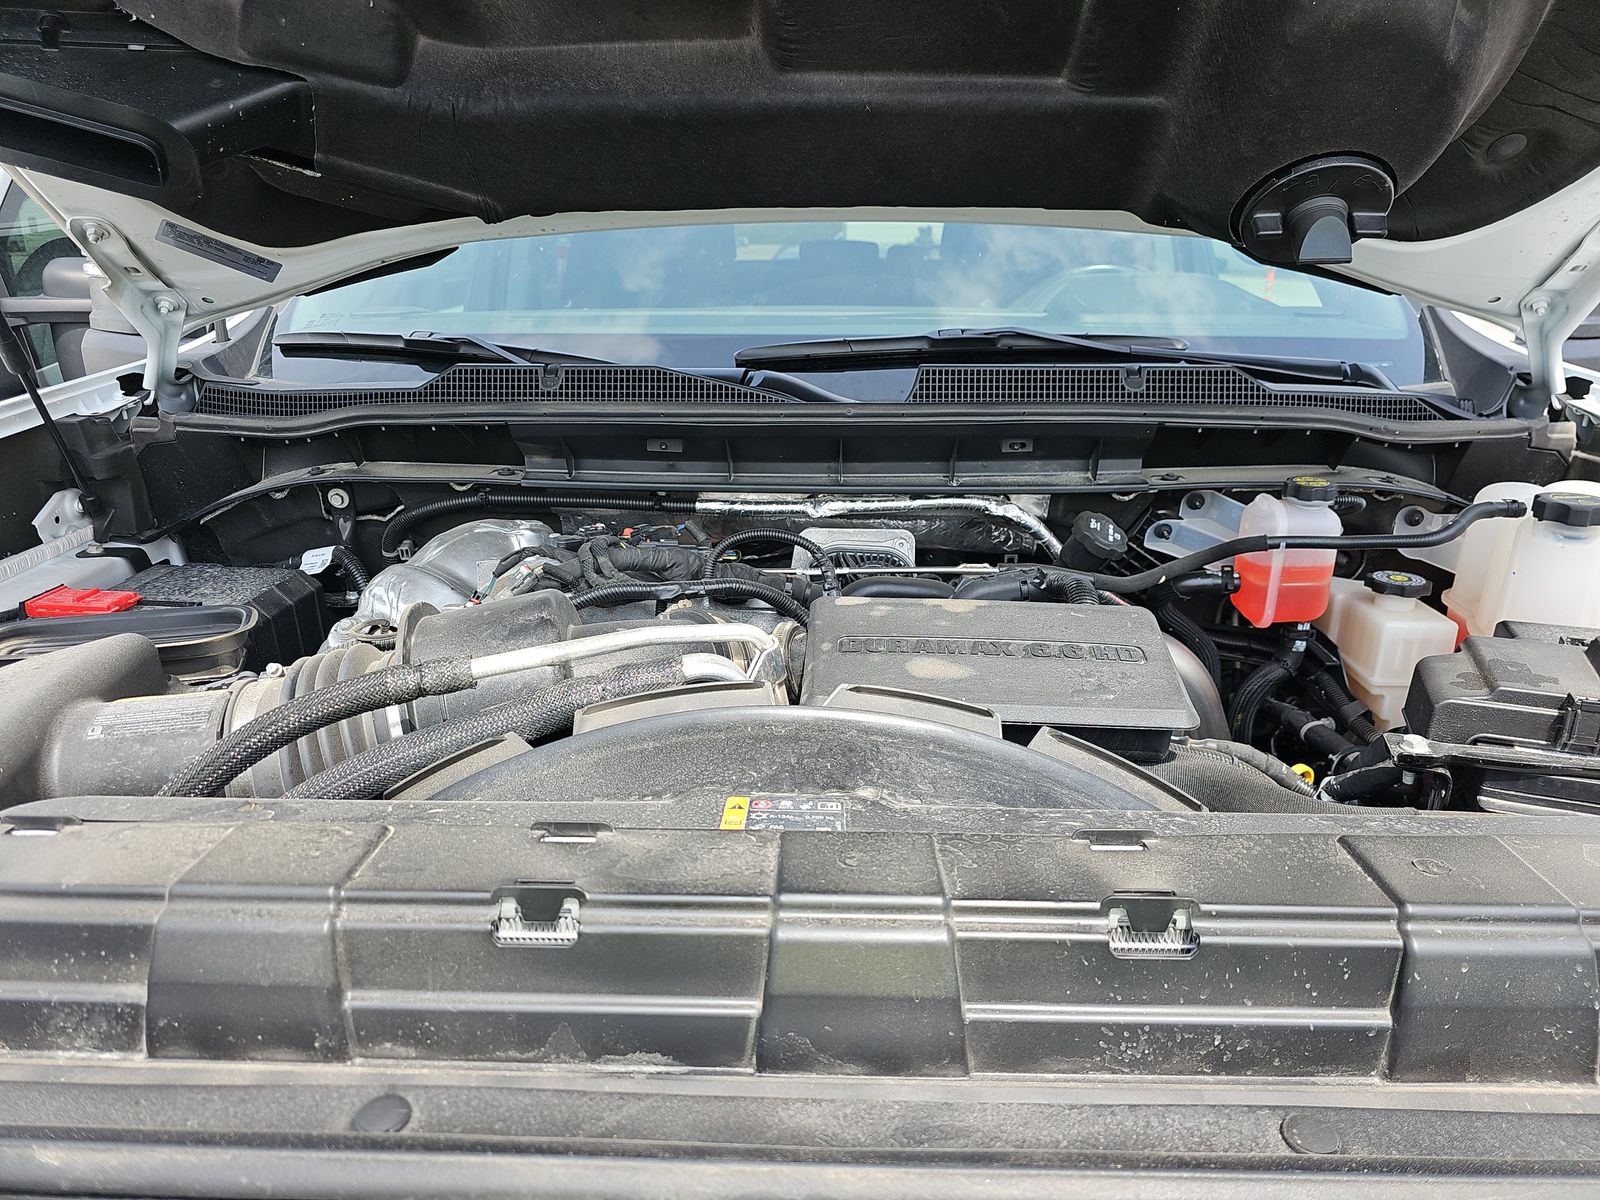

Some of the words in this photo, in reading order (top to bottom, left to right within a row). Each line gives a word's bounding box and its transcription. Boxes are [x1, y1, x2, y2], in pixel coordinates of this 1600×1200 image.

[839, 637, 1016, 657] DURAMAX
[1024, 641, 1084, 660] 6.6
[1093, 645, 1143, 664] HD
